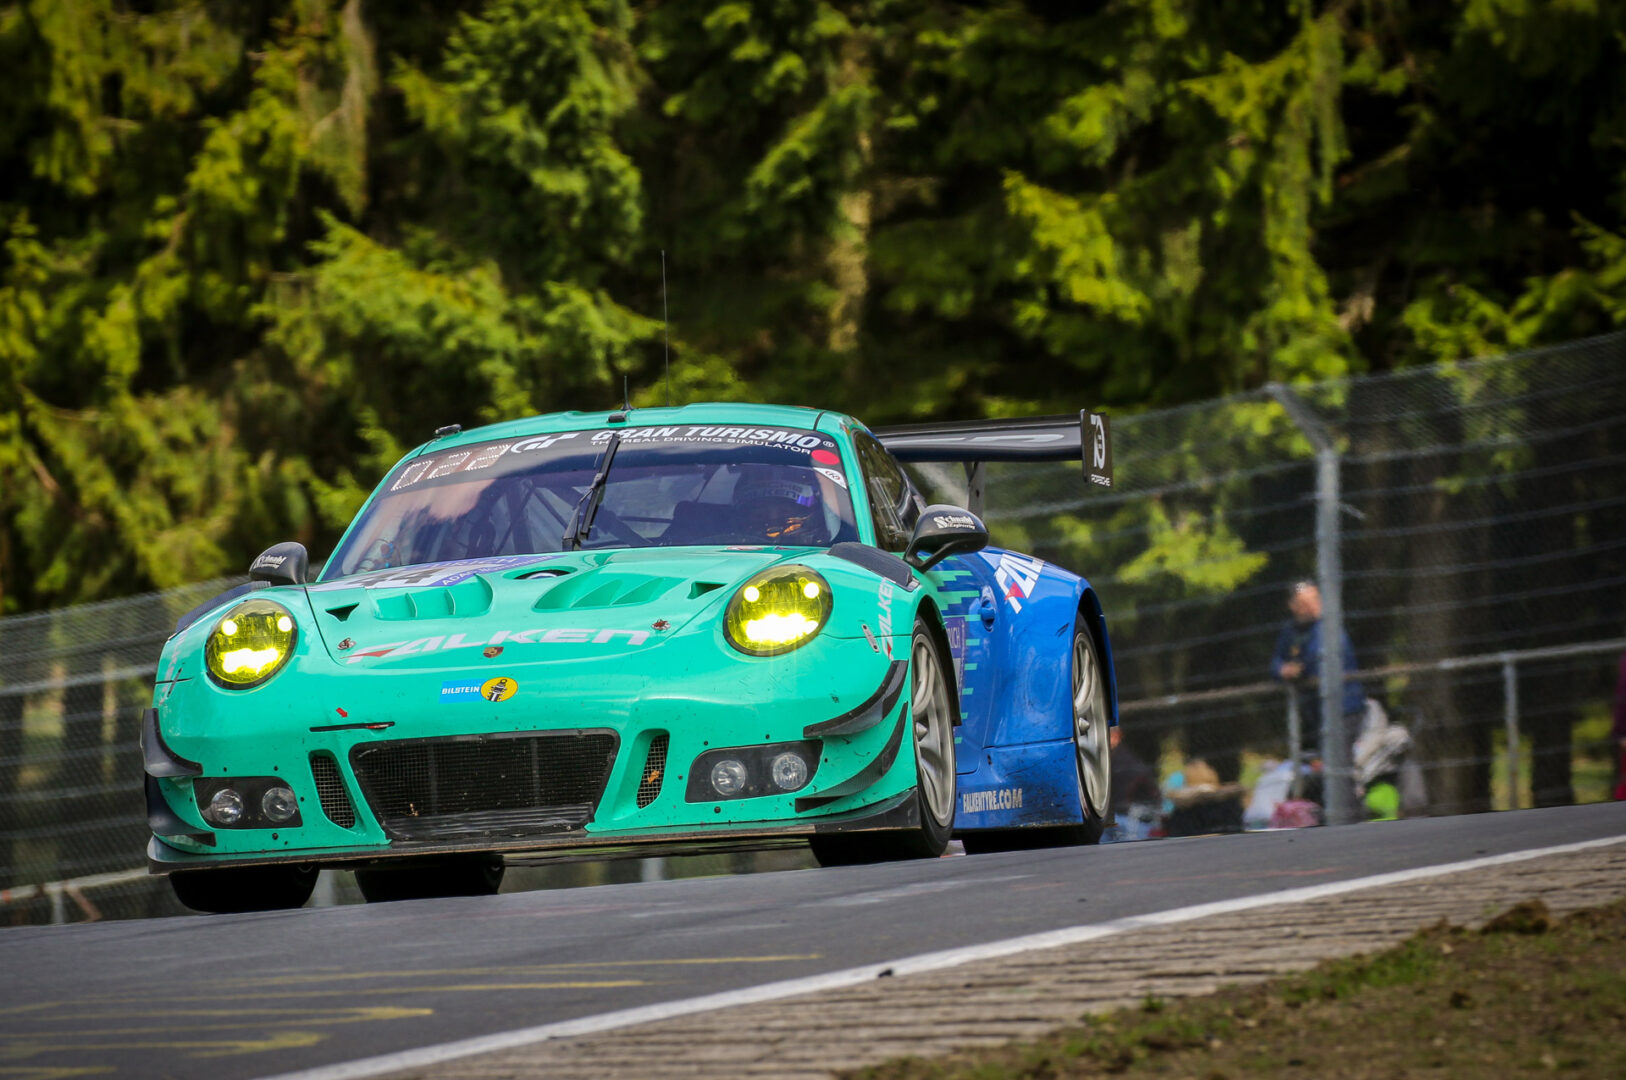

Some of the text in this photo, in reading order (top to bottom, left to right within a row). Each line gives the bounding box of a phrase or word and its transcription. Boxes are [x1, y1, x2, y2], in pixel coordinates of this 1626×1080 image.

[591, 426, 821, 448] GRAN TURISMO
[727, 437, 811, 455] SIMULATOR
[339, 628, 652, 664] FALKEN
[441, 686, 480, 695] BILSTEIN
